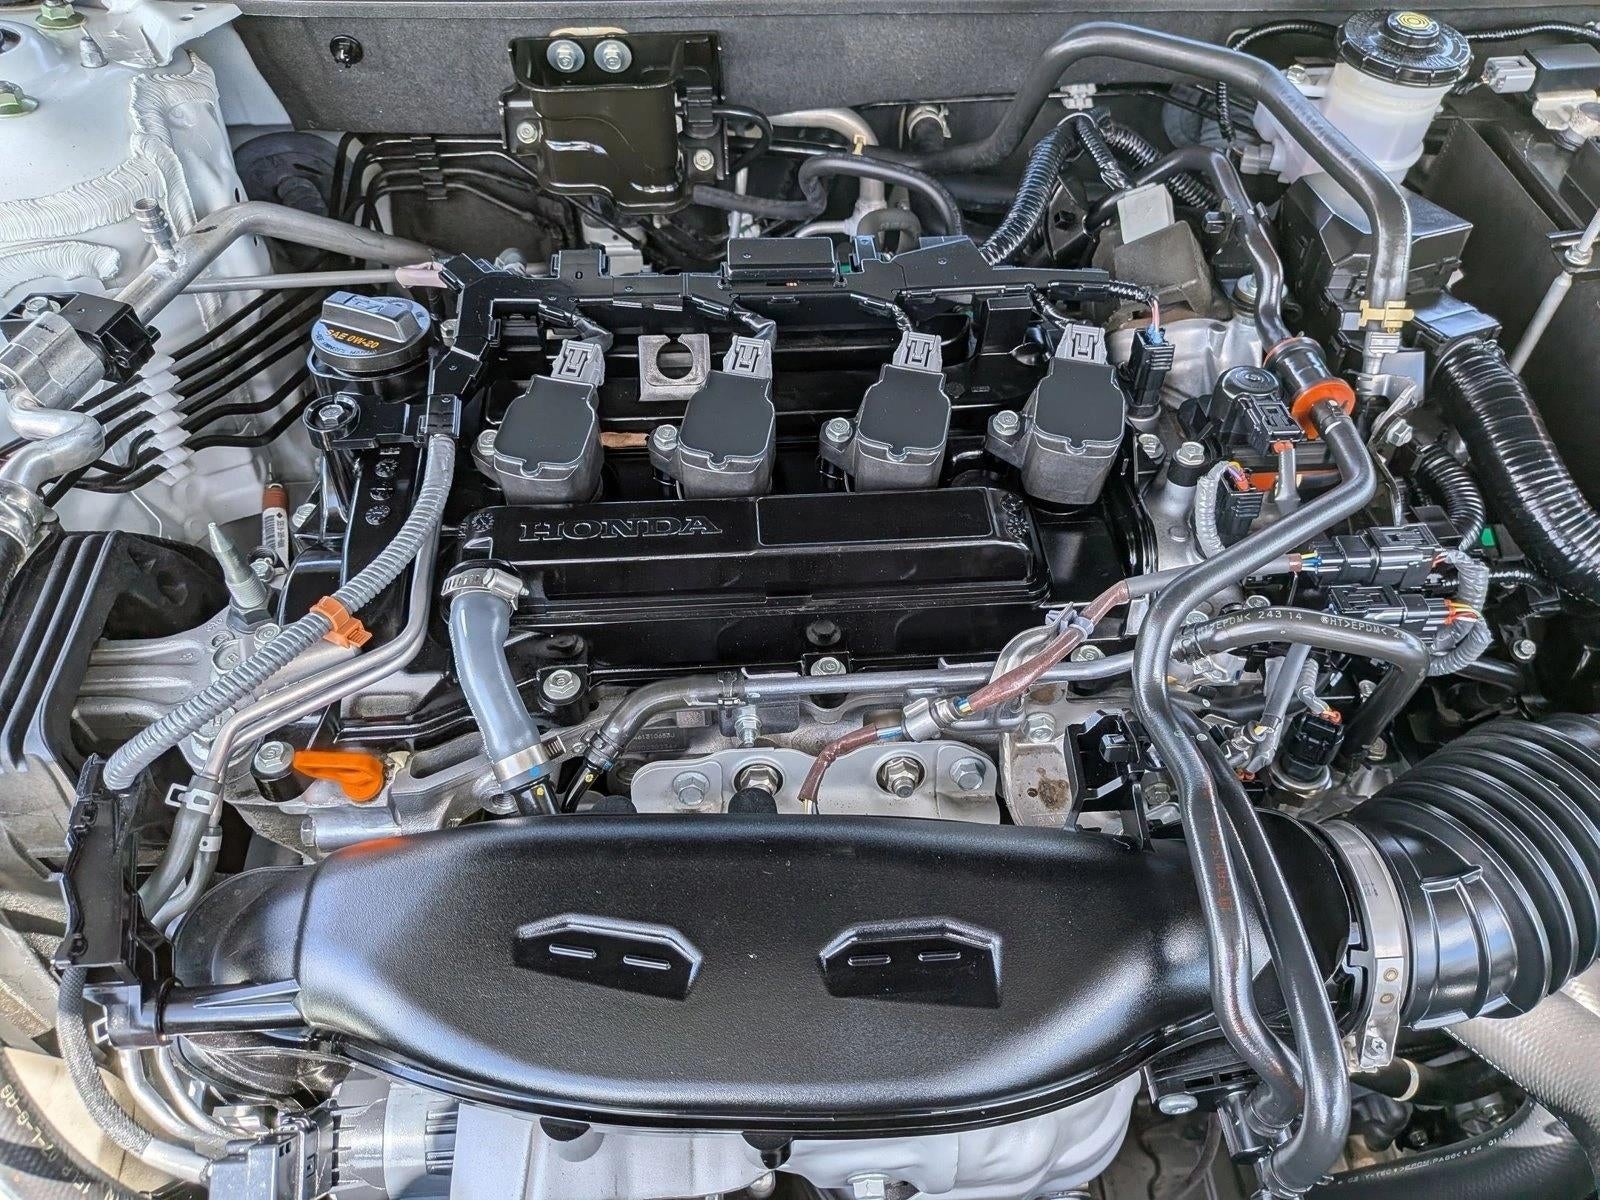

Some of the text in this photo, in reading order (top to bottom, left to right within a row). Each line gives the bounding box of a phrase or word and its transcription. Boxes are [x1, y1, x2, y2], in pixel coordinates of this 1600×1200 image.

[325, 329, 346, 341] SAE
[347, 335, 380, 349] 0W-20
[518, 516, 723, 542] HONDA
